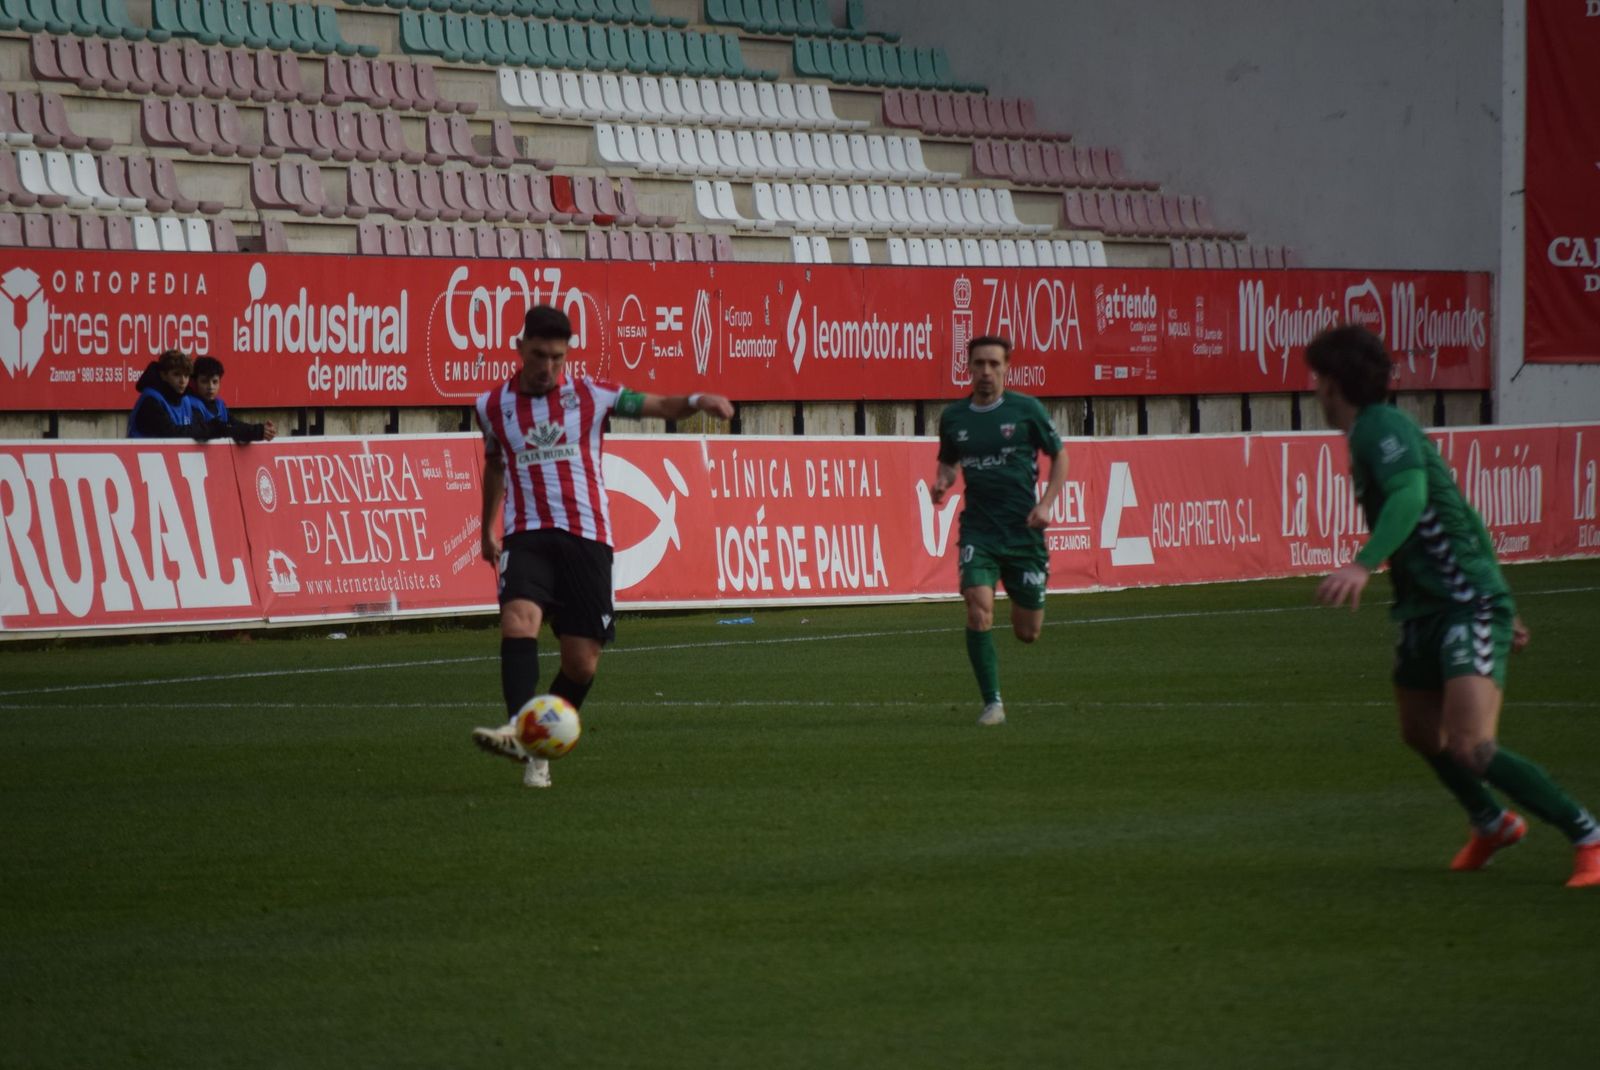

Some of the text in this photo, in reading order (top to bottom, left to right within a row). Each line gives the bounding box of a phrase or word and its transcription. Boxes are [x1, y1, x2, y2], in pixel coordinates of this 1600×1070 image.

[52, 270, 208, 296] ORTOPEDIA
[1105, 283, 1157, 319] atiendo
[49, 304, 209, 356] tres cruces
[233, 286, 408, 354] la industrial
[617, 326, 647, 338] NISSAN
[729, 305, 753, 328] Grupo
[813, 305, 933, 360] leomotor.net
[983, 278, 1083, 352] ZAMORA
[1238, 279, 1340, 384] Melquiades
[1391, 281, 1486, 382] Melquiades
[444, 361, 517, 381] EMBUTIDOS
[729, 333, 777, 359] Leomotor
[49, 366, 76, 382] Zamora
[307, 357, 408, 398] de pinturas
[1003, 366, 1046, 387] TAMIENTO
[274, 452, 423, 505] TERNERA
[708, 449, 882, 498] CLÍNICA DENTAL
[1281, 443, 1308, 537] La
[1574, 432, 1597, 520] La
[0, 452, 253, 617] RURAL
[325, 508, 434, 565] ALISTE
[715, 504, 889, 592] JOSÉ DE PAULA
[1153, 499, 1236, 551] AISLAPRIETO,
[1290, 541, 1301, 566] El
[306, 571, 441, 595] www.terneradealiste.es
